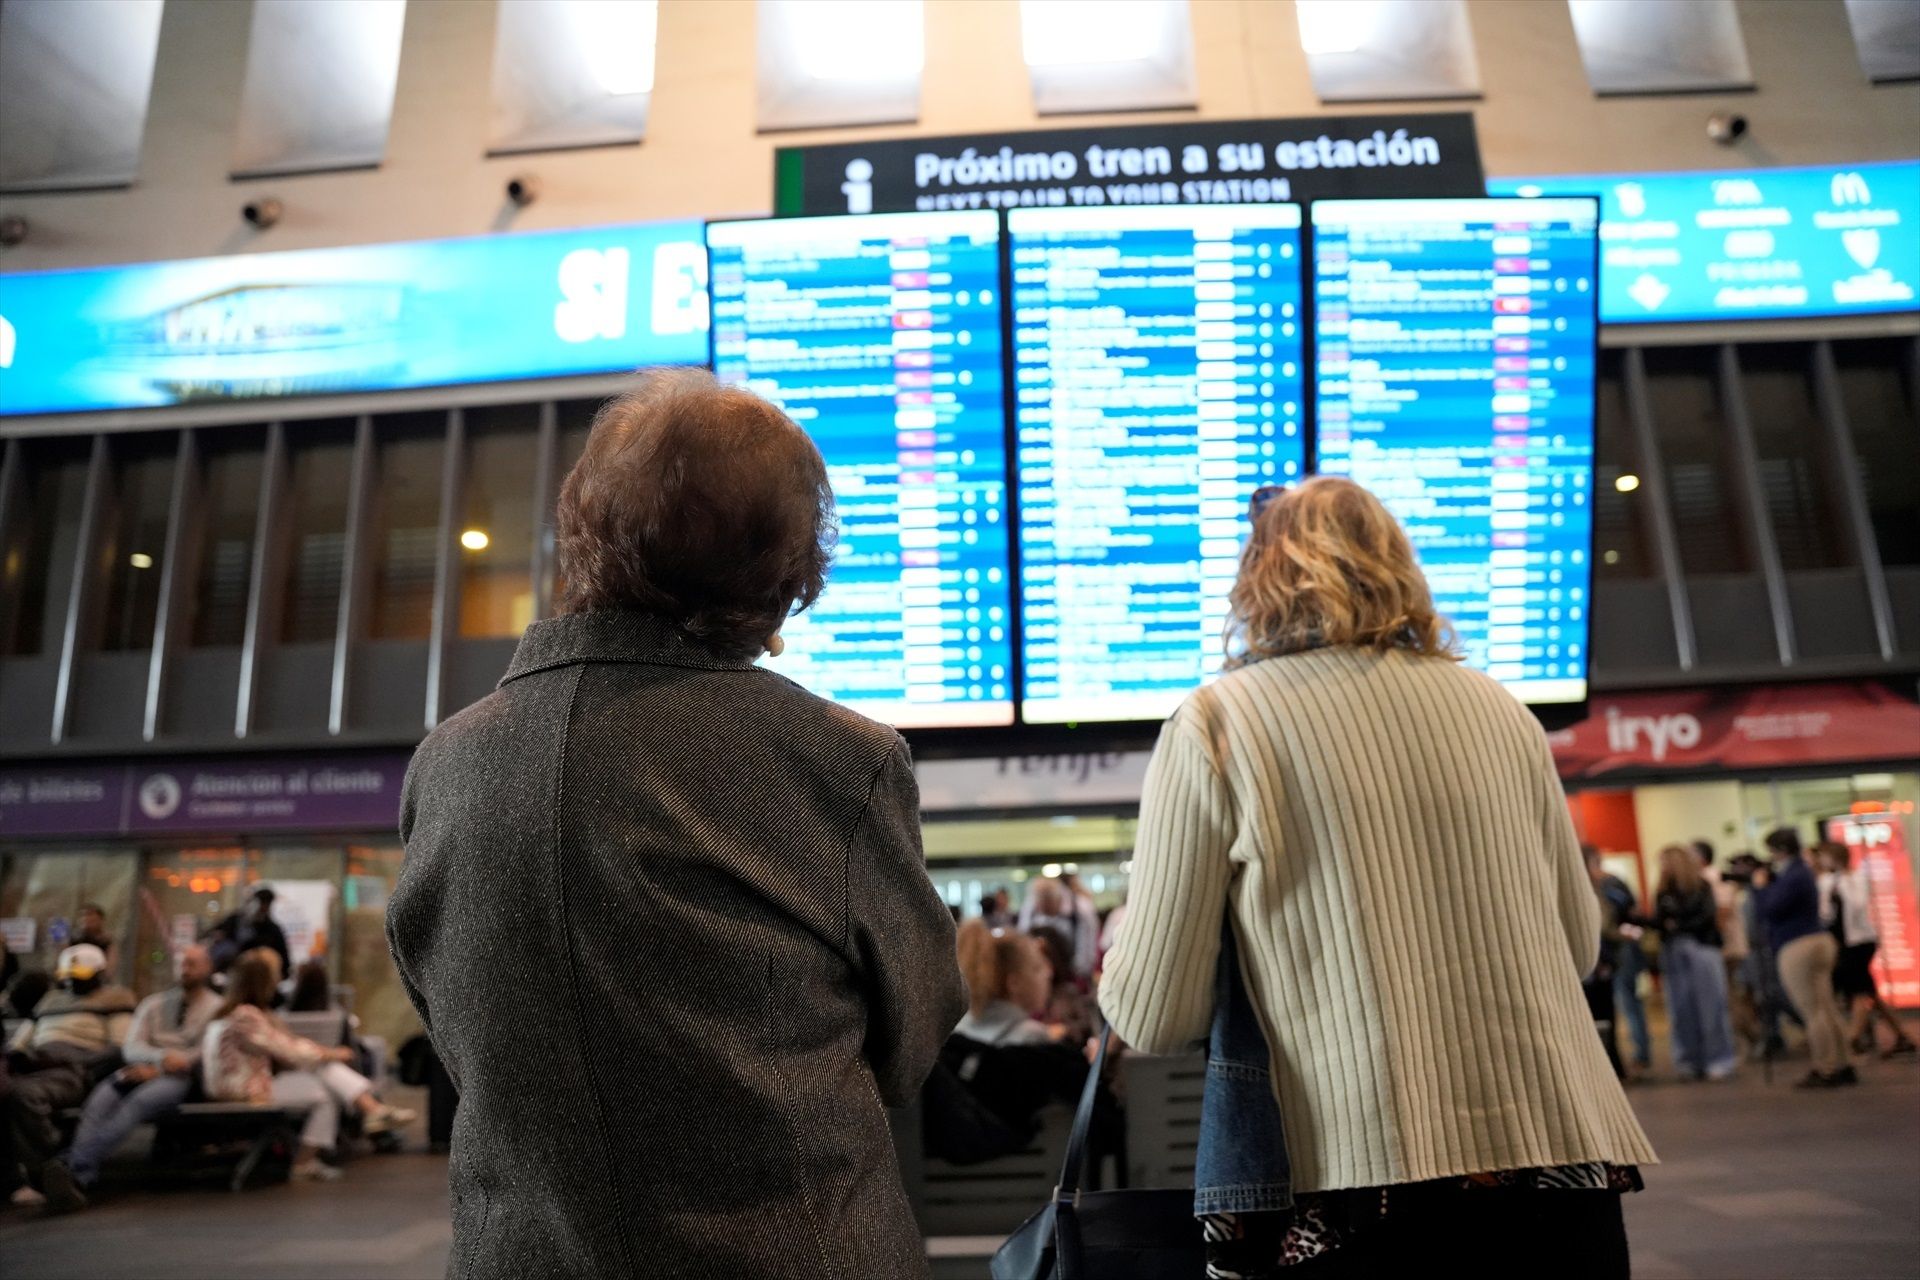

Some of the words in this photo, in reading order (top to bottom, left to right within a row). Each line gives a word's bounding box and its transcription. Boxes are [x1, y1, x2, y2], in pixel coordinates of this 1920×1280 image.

[915, 146, 1078, 187] Próximo
[1084, 144, 1171, 178] tren
[1182, 145, 1208, 174] a
[1217, 142, 1265, 172] su
[1275, 128, 1440, 170] estación
[1181, 177, 1291, 203] STATION
[1605, 705, 1701, 761] iryo
